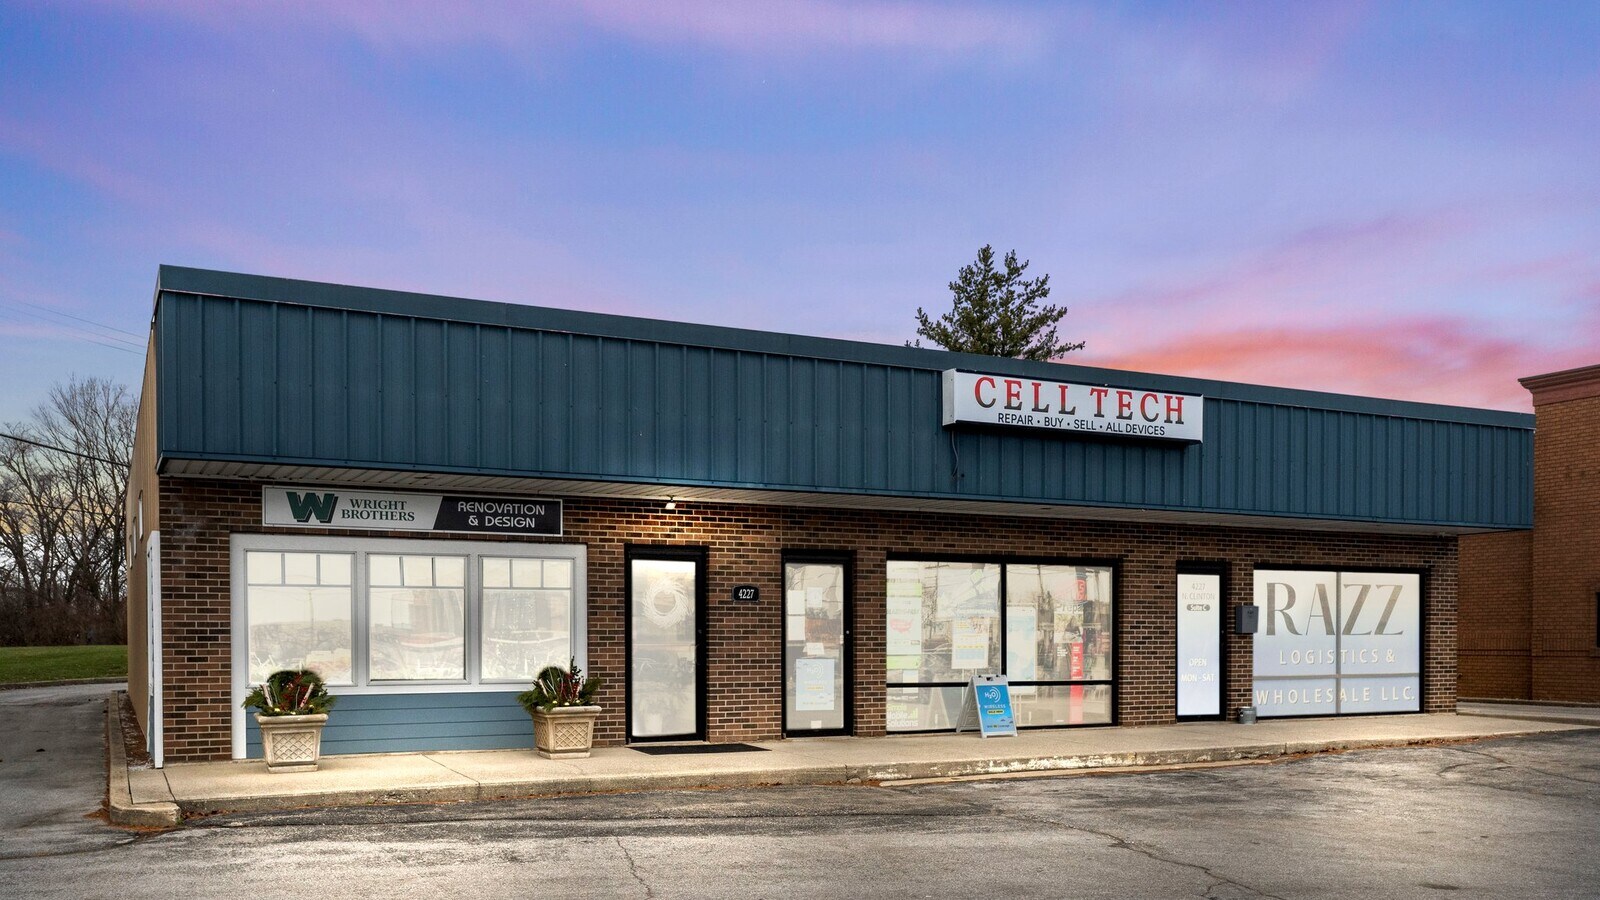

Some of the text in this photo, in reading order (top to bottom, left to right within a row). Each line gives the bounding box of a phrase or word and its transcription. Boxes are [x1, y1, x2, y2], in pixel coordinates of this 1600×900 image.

[974, 376, 1185, 425] CELL TECH
[998, 412, 1165, 436] REPAIR BUY SELL ALL DEVICES
[285, 491, 339, 524] W
[349, 498, 407, 510] WRIGHT
[457, 501, 545, 516] RENOVATION
[341, 508, 415, 522] BROTHERS
[468, 515, 536, 528] & DESIGN
[738, 588, 755, 599] 4227
[1265, 582, 1404, 636] RAZZ
[1189, 657, 1208, 667] OPEN
[1279, 648, 1396, 666] LOGISTICS &
[1256, 687, 1371, 705] WHOLESALE
